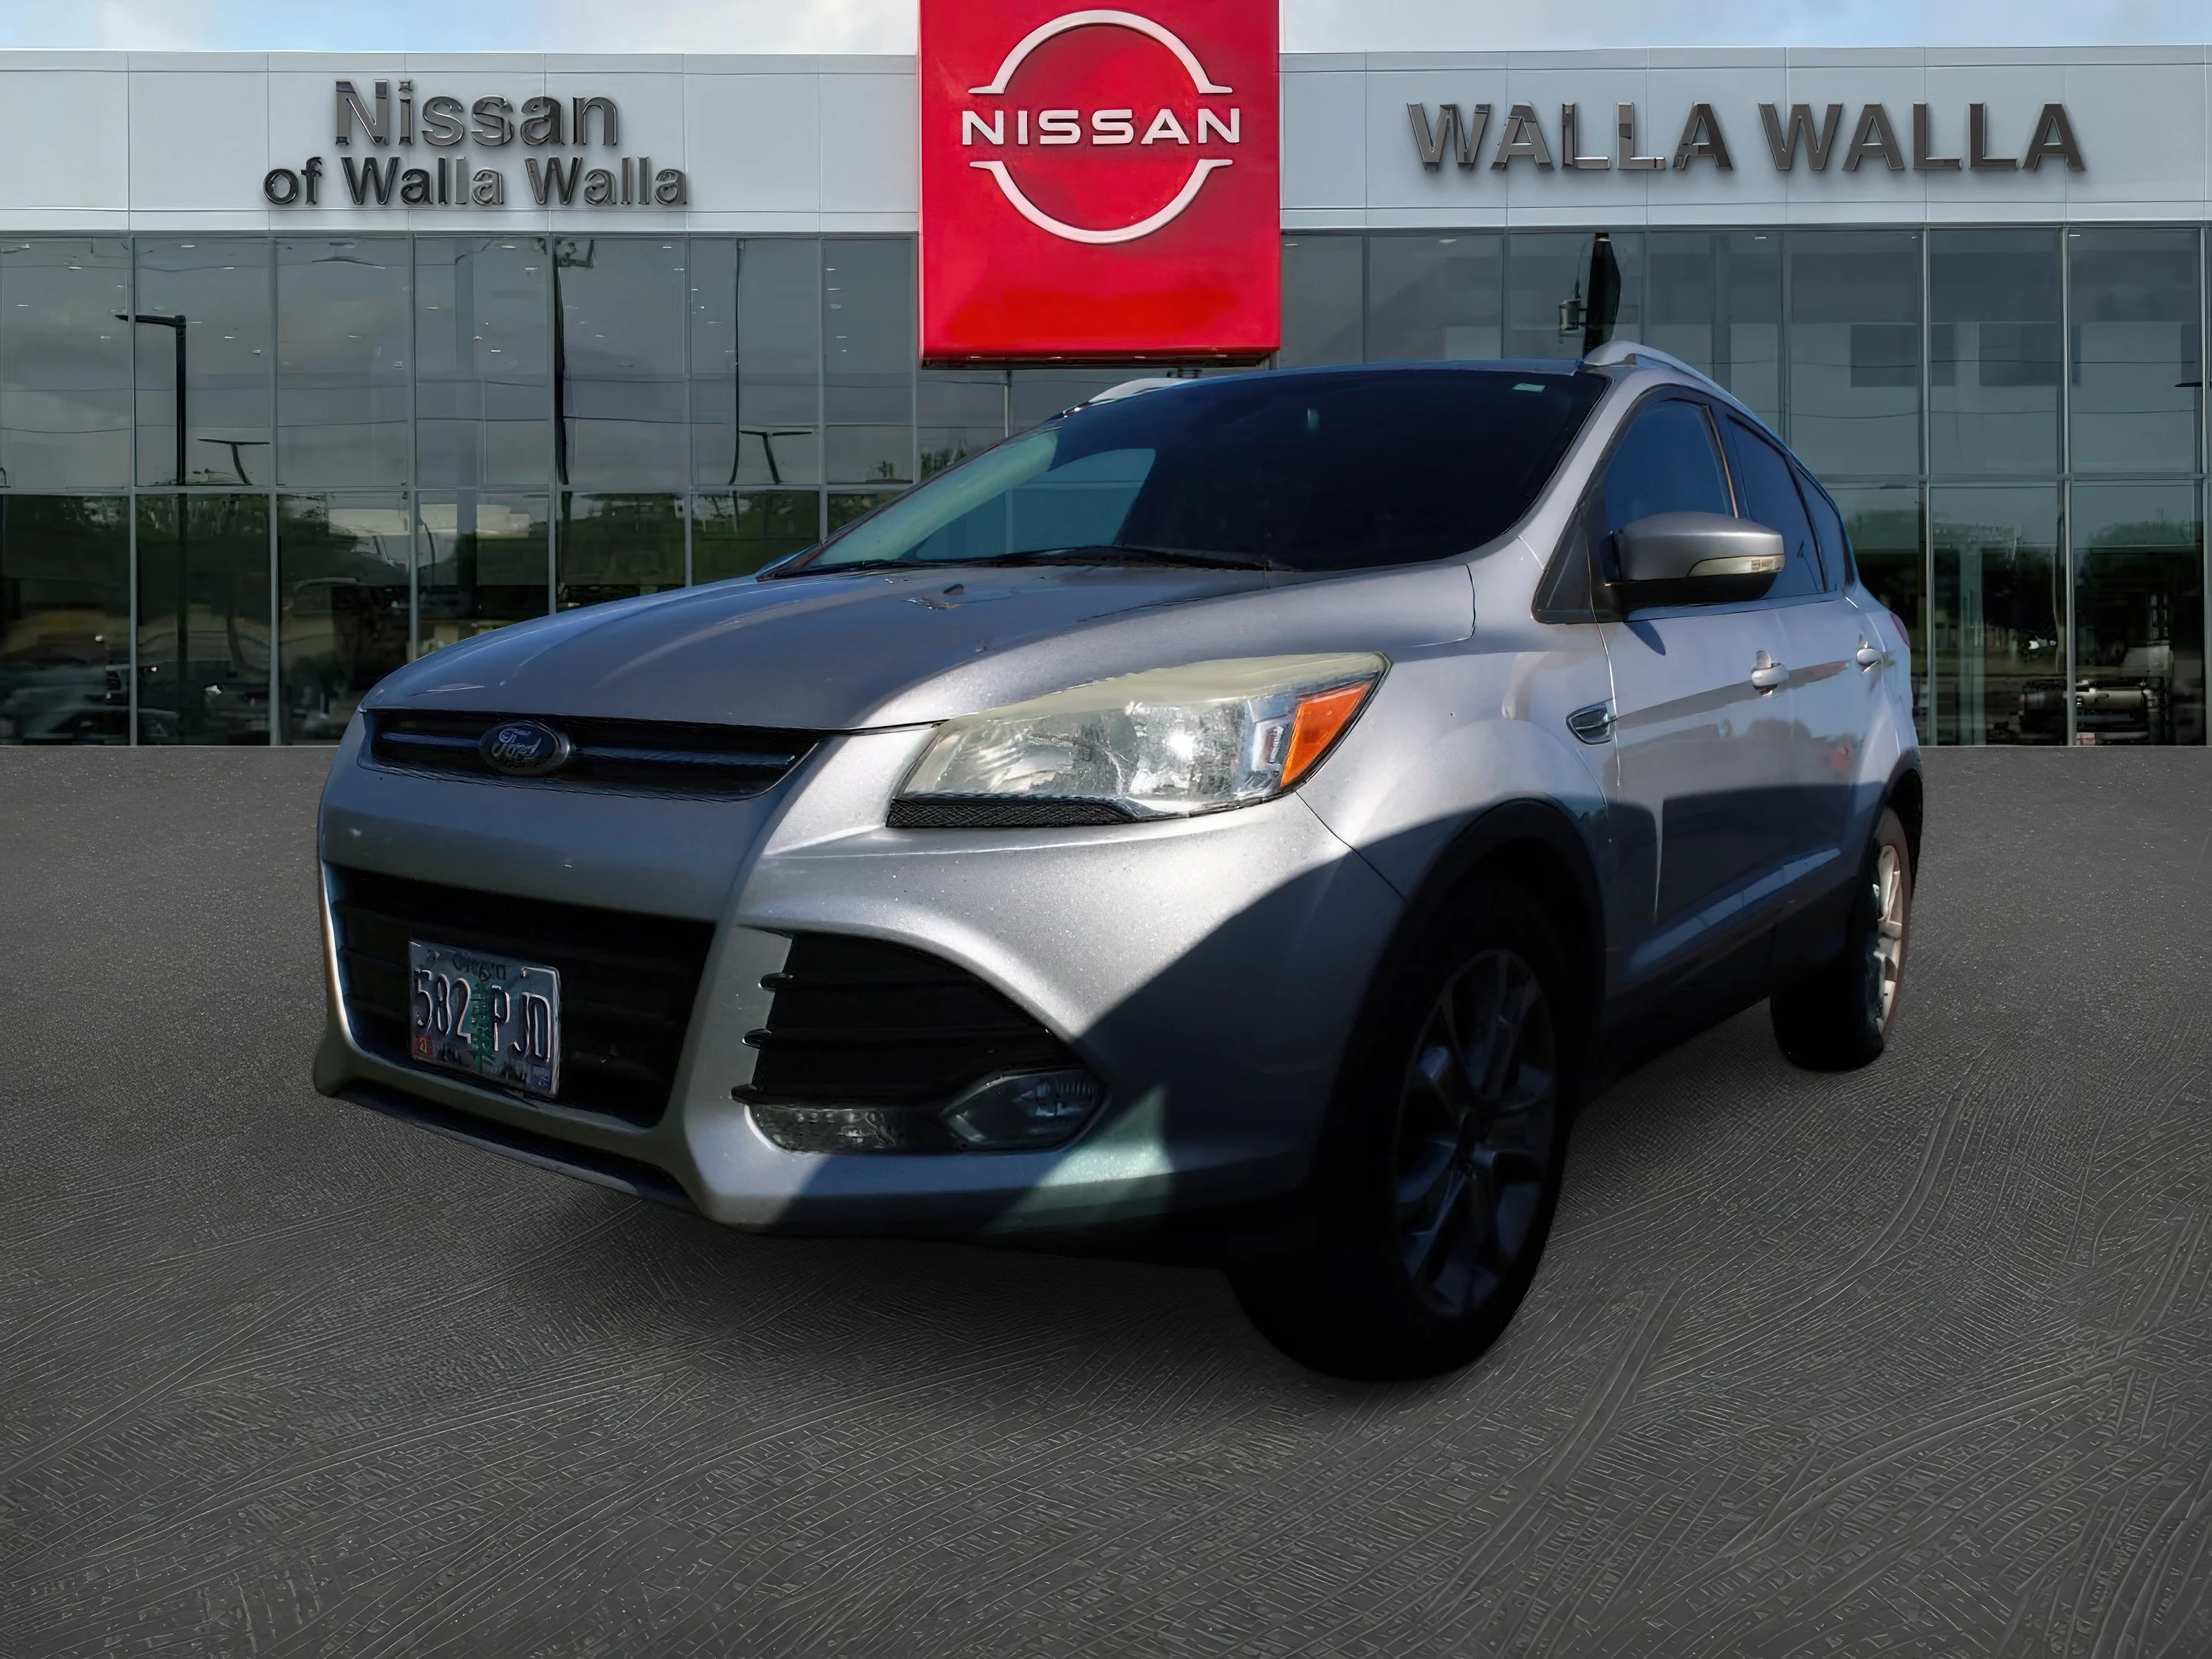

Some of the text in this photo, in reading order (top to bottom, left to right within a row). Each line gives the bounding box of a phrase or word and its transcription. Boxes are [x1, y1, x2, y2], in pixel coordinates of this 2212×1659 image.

[335, 79, 618, 146] Nissan
[962, 108, 1240, 145] NISSAN
[1406, 101, 2086, 172] WALLA WALLA
[262, 156, 688, 205] of Walla Walla
[492, 728, 543, 760] Ford
[413, 968, 472, 1045] 582
